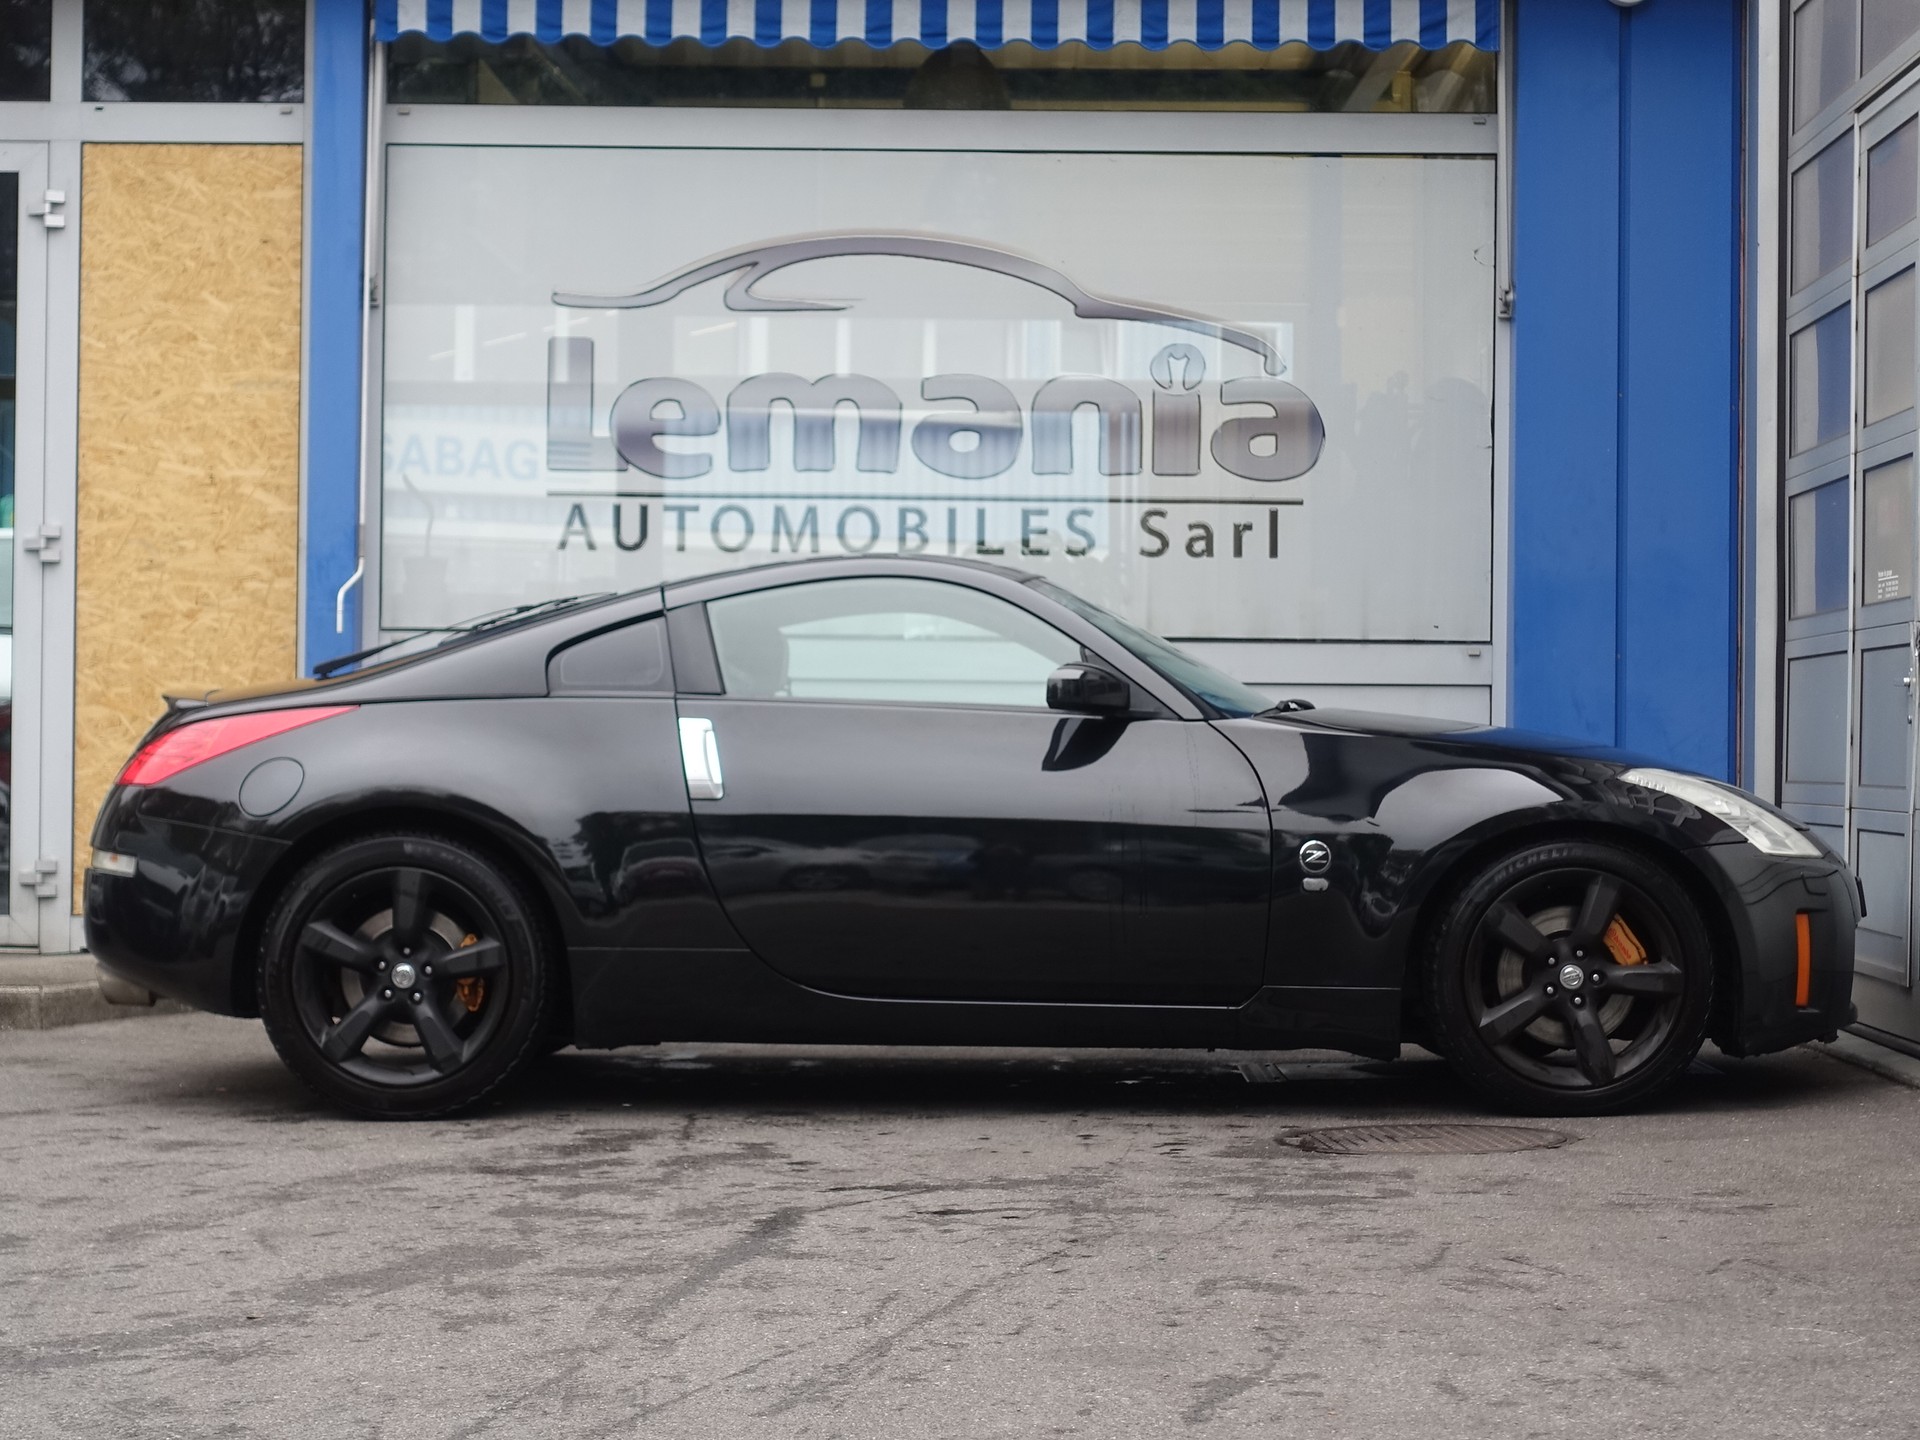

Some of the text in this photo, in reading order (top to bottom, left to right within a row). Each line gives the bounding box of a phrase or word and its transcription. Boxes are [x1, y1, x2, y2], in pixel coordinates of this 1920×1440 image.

[546, 336, 1326, 482] Lemania
[557, 503, 1279, 560] AUTOMOBILES Sarl
[1494, 848, 1582, 882] MICHELIN
